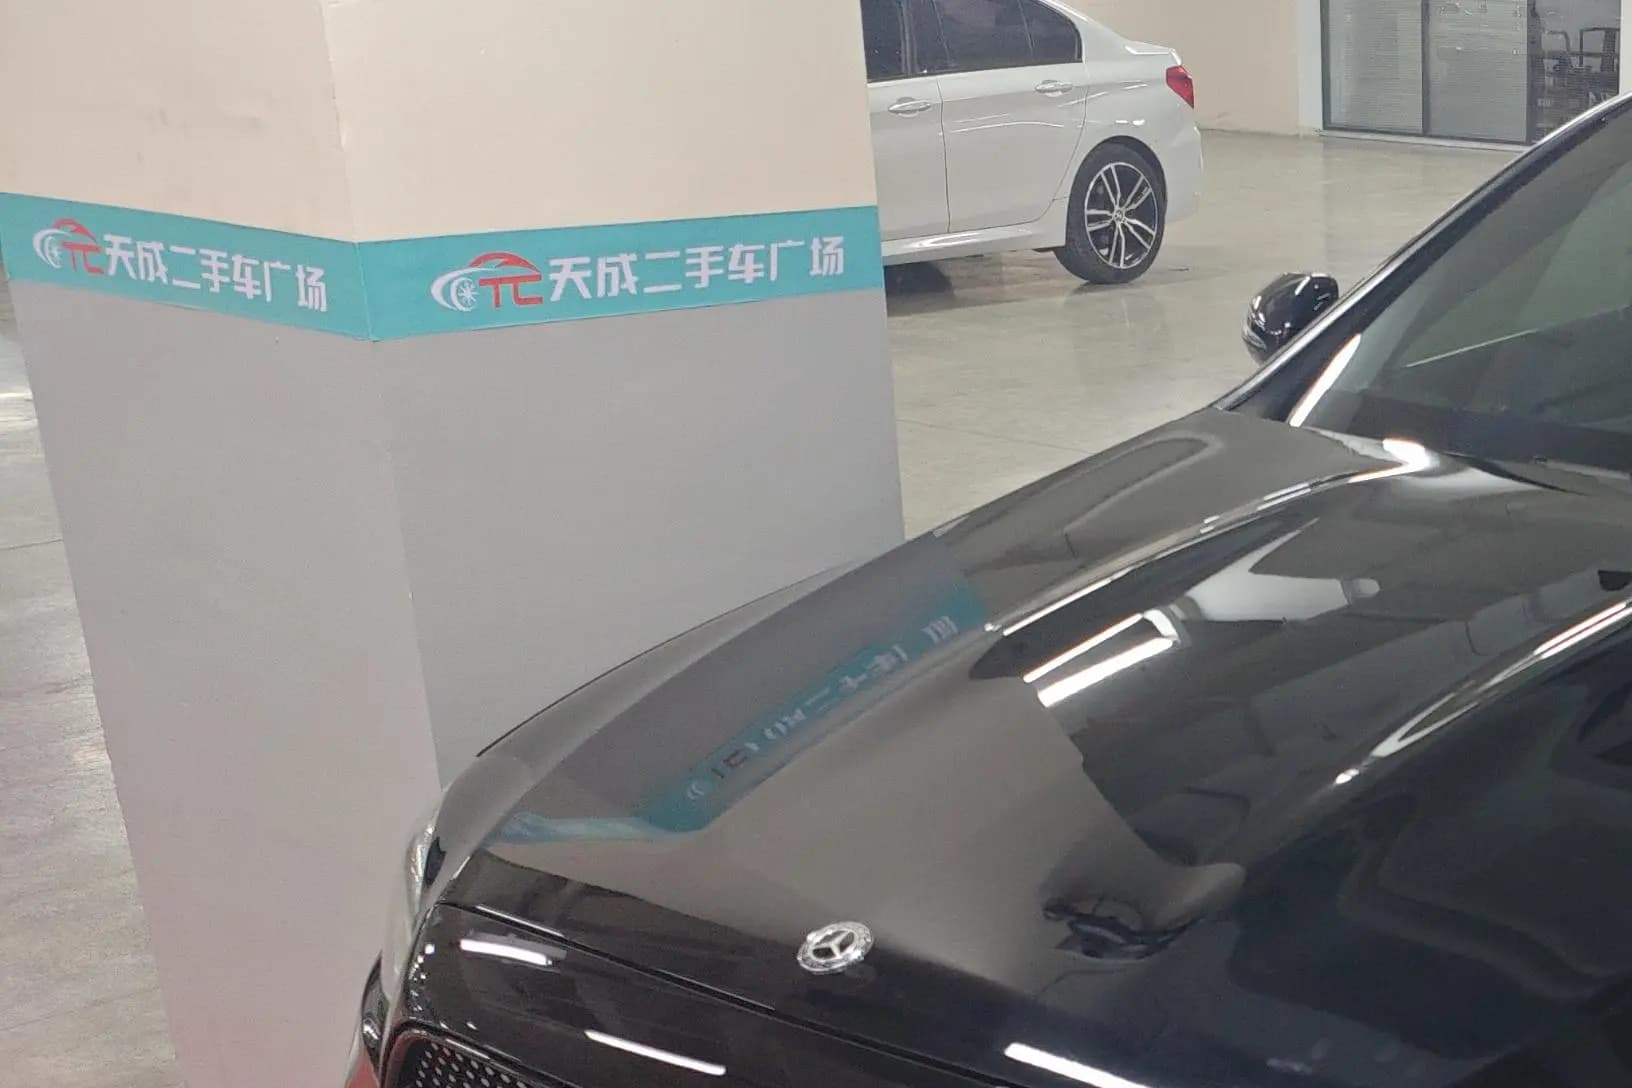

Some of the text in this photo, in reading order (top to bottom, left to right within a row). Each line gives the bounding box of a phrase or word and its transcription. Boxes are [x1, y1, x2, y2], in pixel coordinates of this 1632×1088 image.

[103, 233, 327, 312] 天成二手车广场
[549, 236, 845, 302] 天成二手车广场
